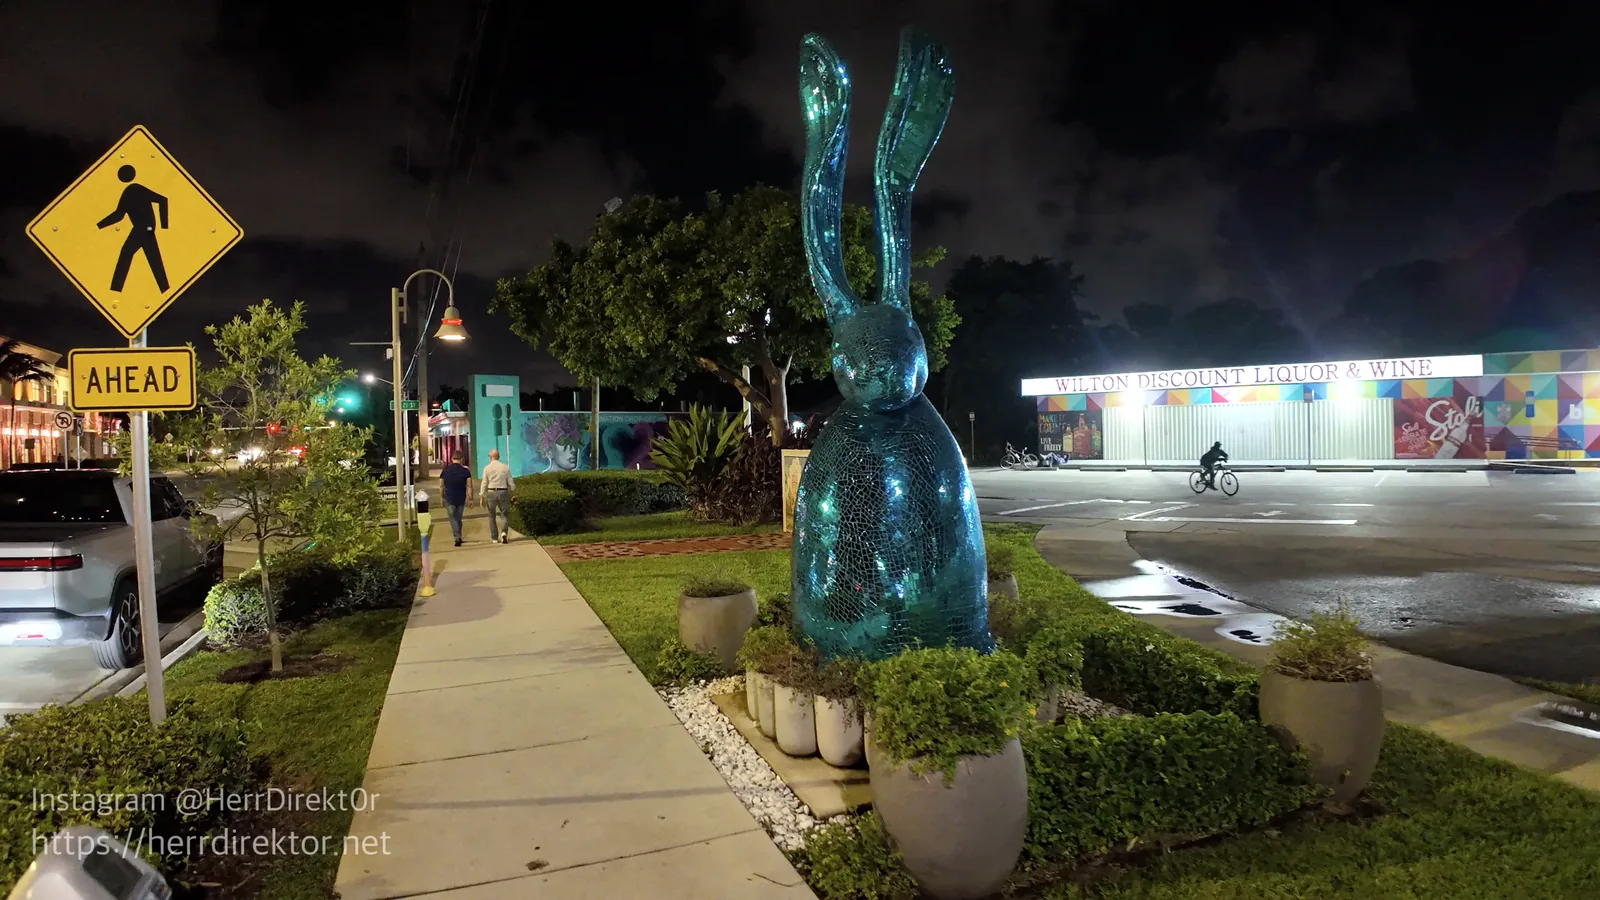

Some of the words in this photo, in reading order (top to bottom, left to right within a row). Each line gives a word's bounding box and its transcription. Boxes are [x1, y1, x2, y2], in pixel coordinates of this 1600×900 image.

[86, 366, 179, 393] AHEAD
[1055, 375, 1129, 392] WILTON
[1138, 368, 1245, 389] DISCOUNT
[1255, 363, 1339, 382] LIQUOR
[1346, 363, 1361, 379] &
[1369, 359, 1432, 377] WINE
[1425, 396, 1483, 441] Stoli
